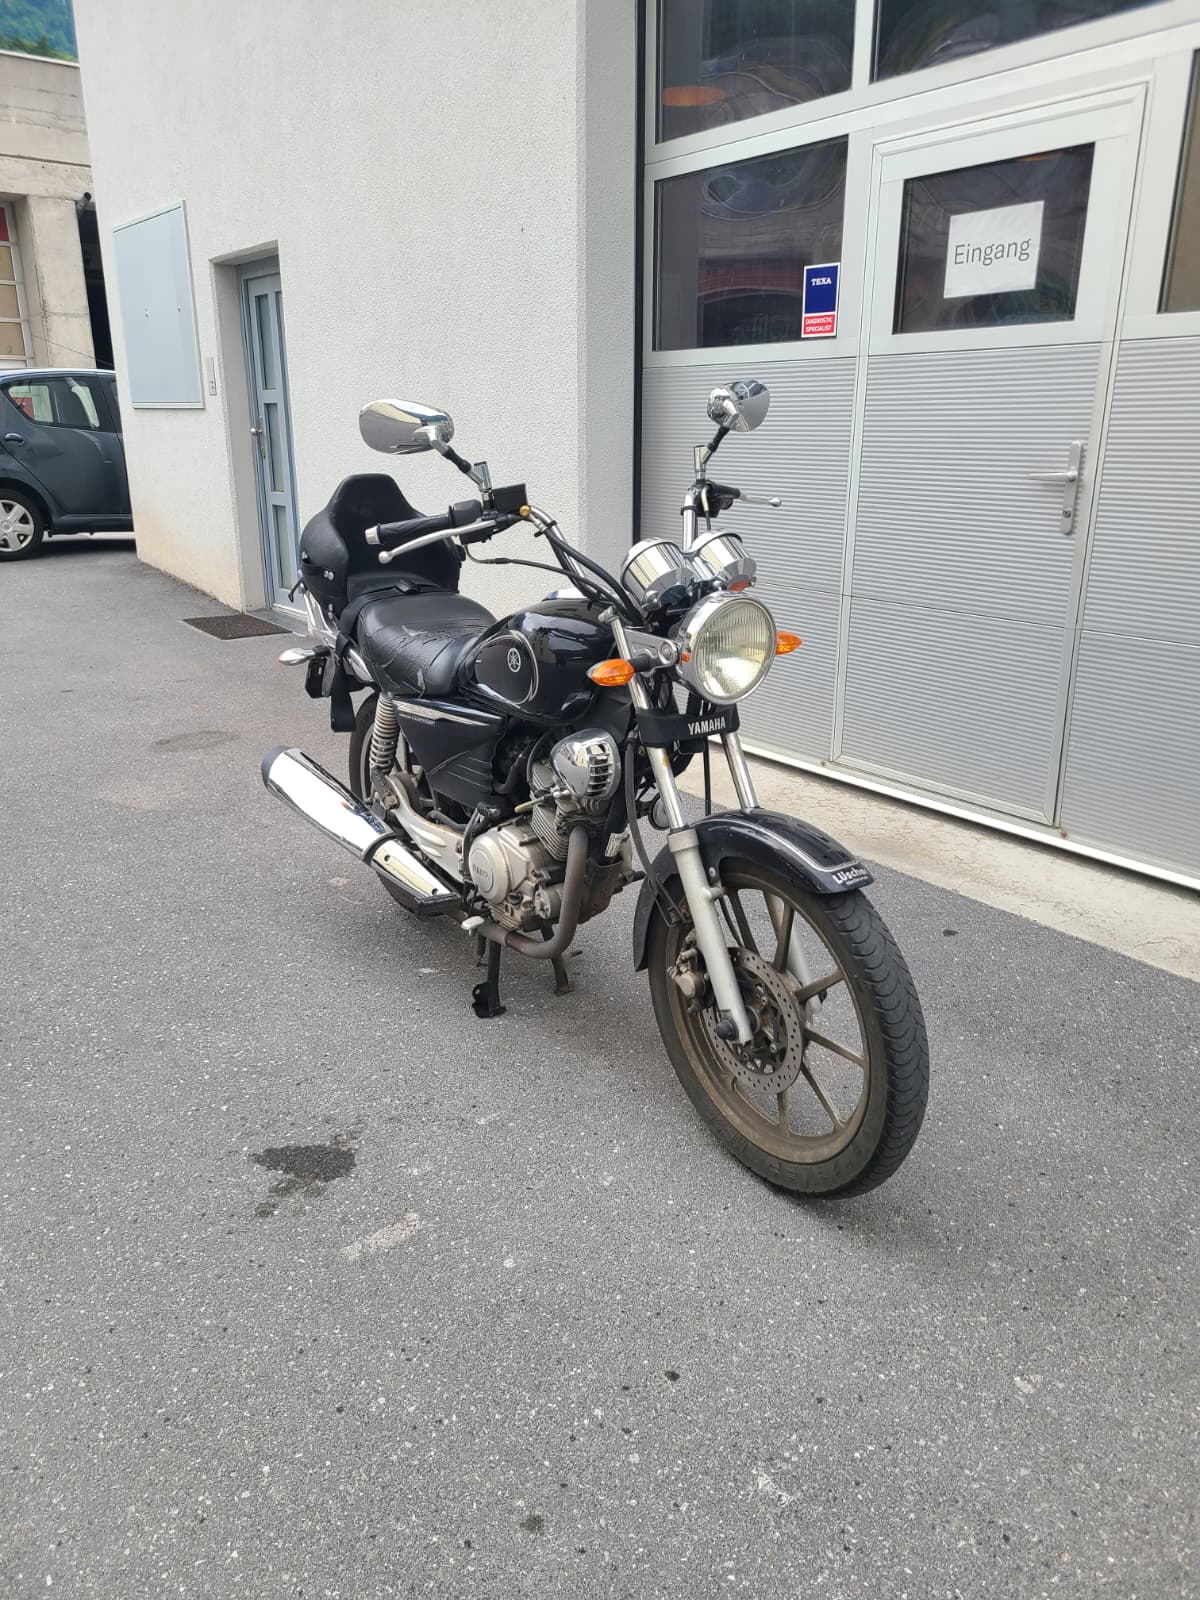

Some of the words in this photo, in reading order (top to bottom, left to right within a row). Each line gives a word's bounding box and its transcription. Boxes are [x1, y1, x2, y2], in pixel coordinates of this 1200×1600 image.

[954, 238, 1032, 266] Eingang
[811, 277, 832, 286] TEXA
[688, 717, 726, 736] YAMAHA
